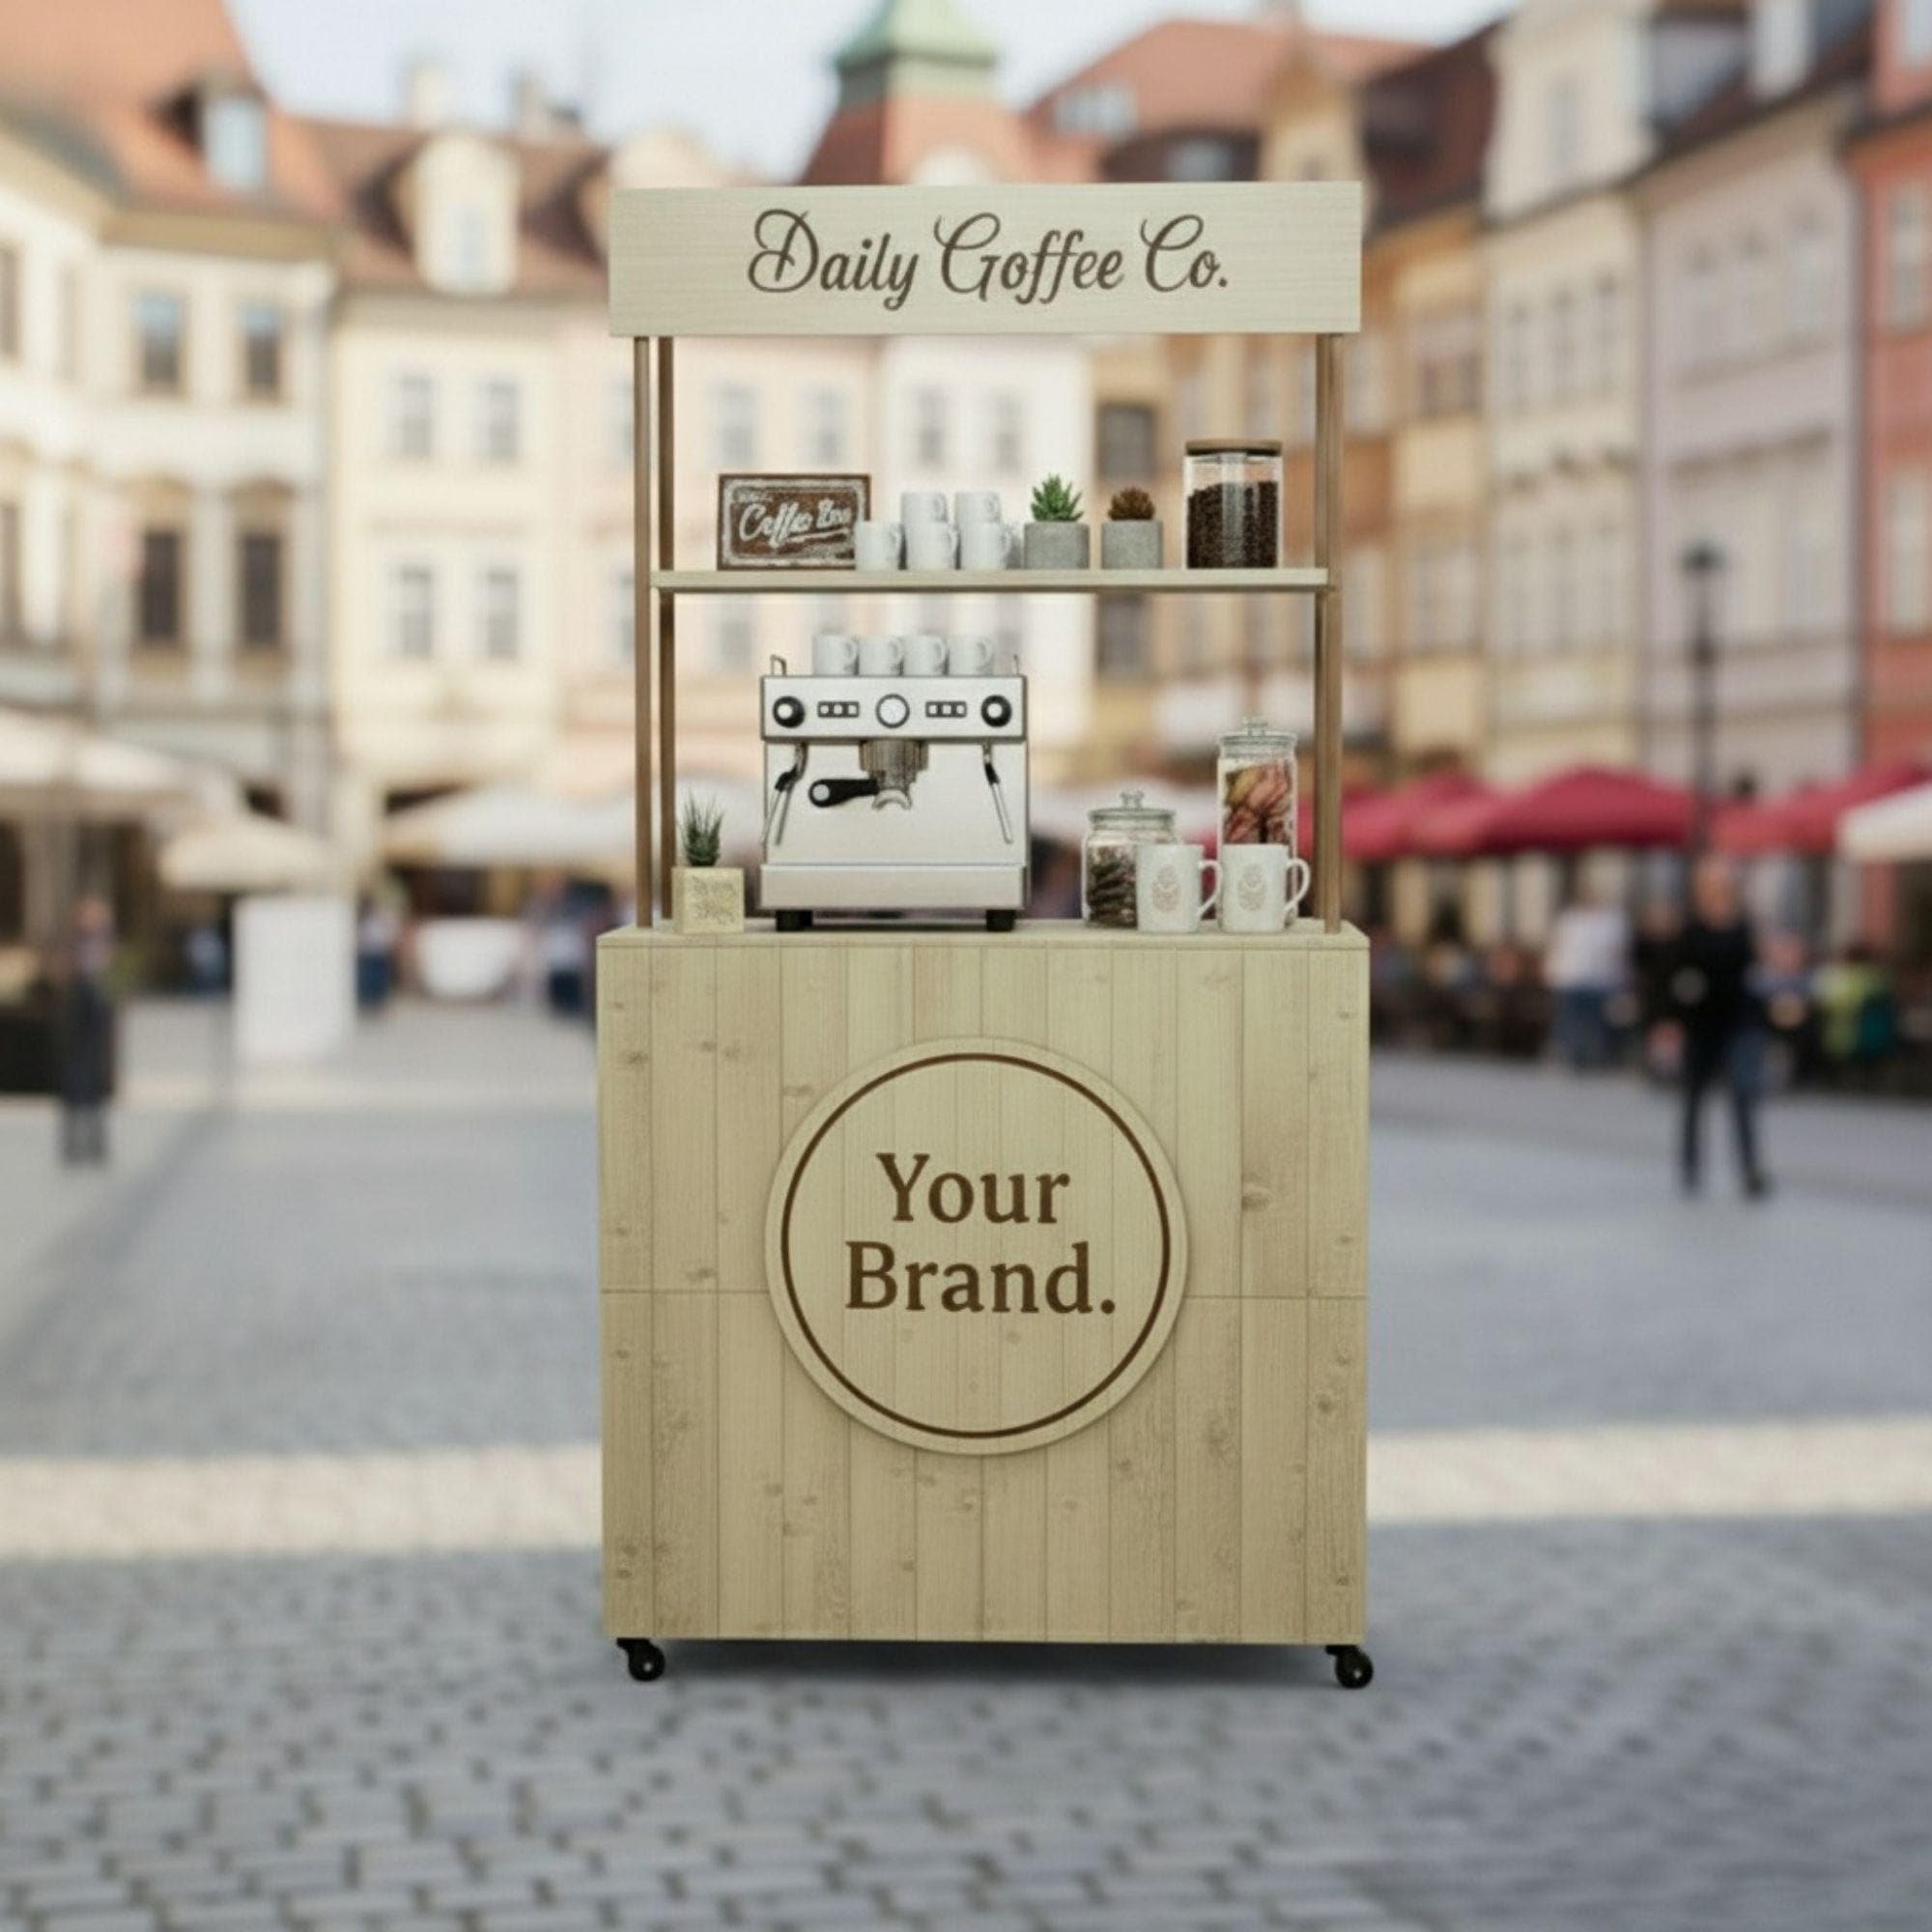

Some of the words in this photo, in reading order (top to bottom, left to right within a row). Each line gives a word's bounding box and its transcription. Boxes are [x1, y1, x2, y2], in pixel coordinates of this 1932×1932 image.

[747, 208, 920, 312] Daily
[1139, 213, 1229, 294] Co.
[875, 1152, 1071, 1225] Your
[845, 1240, 1116, 1315] Brand.
